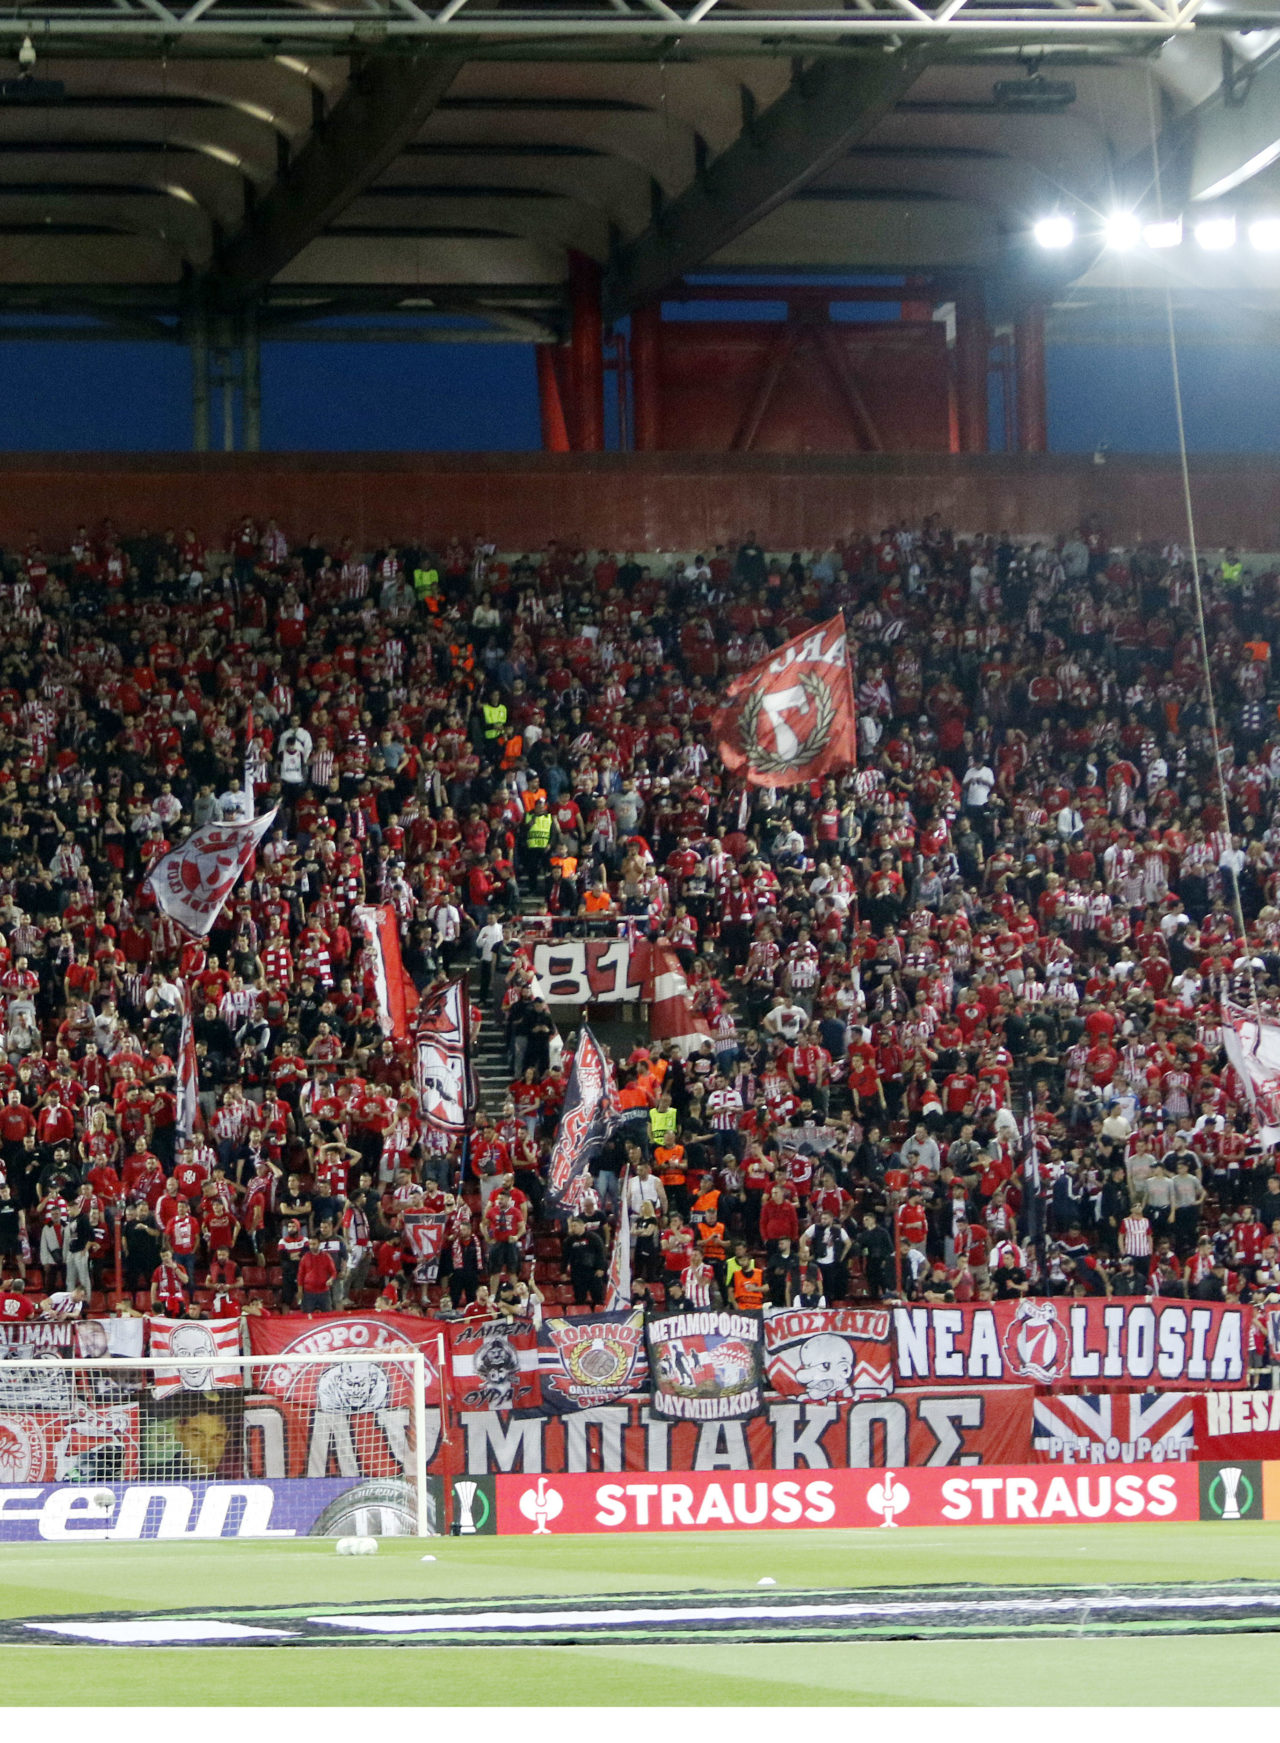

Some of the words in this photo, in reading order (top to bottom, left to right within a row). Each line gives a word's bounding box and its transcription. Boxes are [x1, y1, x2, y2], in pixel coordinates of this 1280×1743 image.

[533, 941, 641, 1004] 81
[648, 1312, 759, 1344] ΜΕΤΑΜΟΡΦΩΣΗ
[763, 1311, 889, 1348] ΜΟΣΧΑΤΟ
[894, 1307, 1003, 1380] NEA
[1070, 1305, 1244, 1381] LIOSIA
[1025, 1324, 1049, 1366] 7
[655, 1386, 760, 1419] ΟΛΥΜΠΙΑΚΟΣ
[595, 1481, 836, 1526] STRAUSS
[941, 1474, 1178, 1520] STRAUSS
